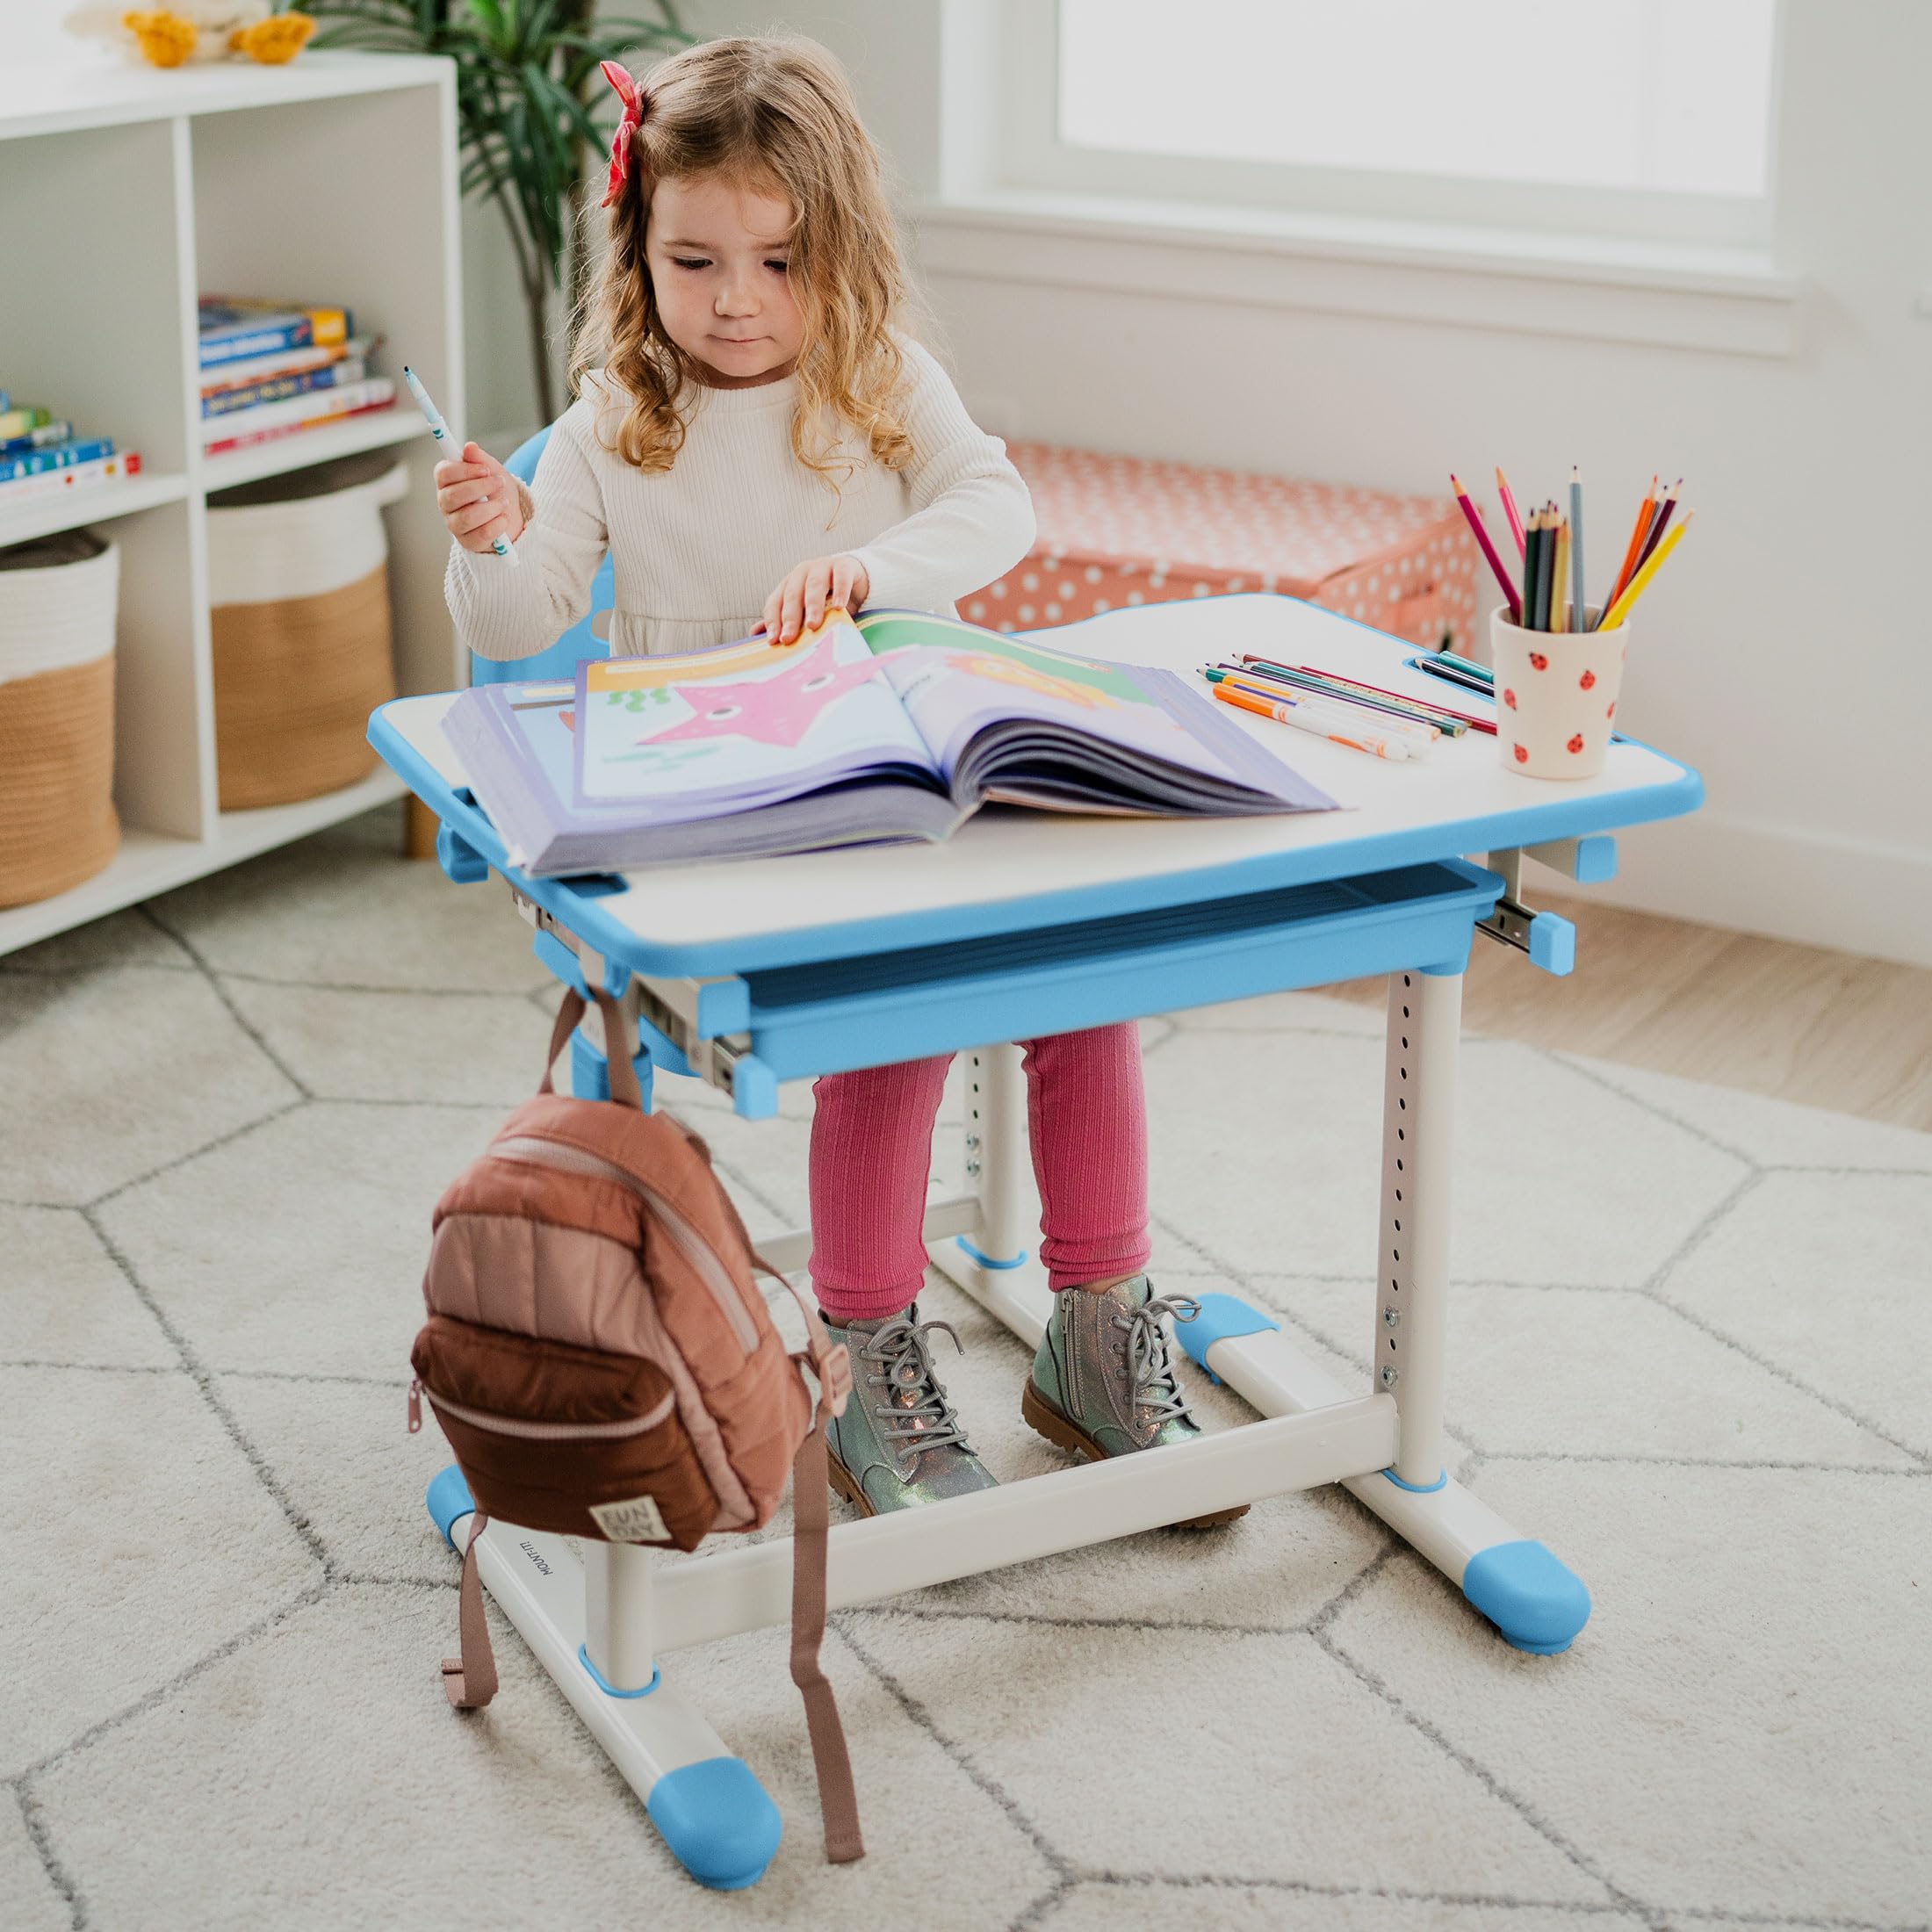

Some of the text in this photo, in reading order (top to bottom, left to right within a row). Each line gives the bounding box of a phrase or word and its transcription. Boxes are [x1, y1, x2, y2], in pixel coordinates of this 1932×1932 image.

[602, 1503, 651, 1527] FUN
[611, 1522, 655, 1539] DAY
[519, 1540, 553, 1576] MOUNT-IT!
